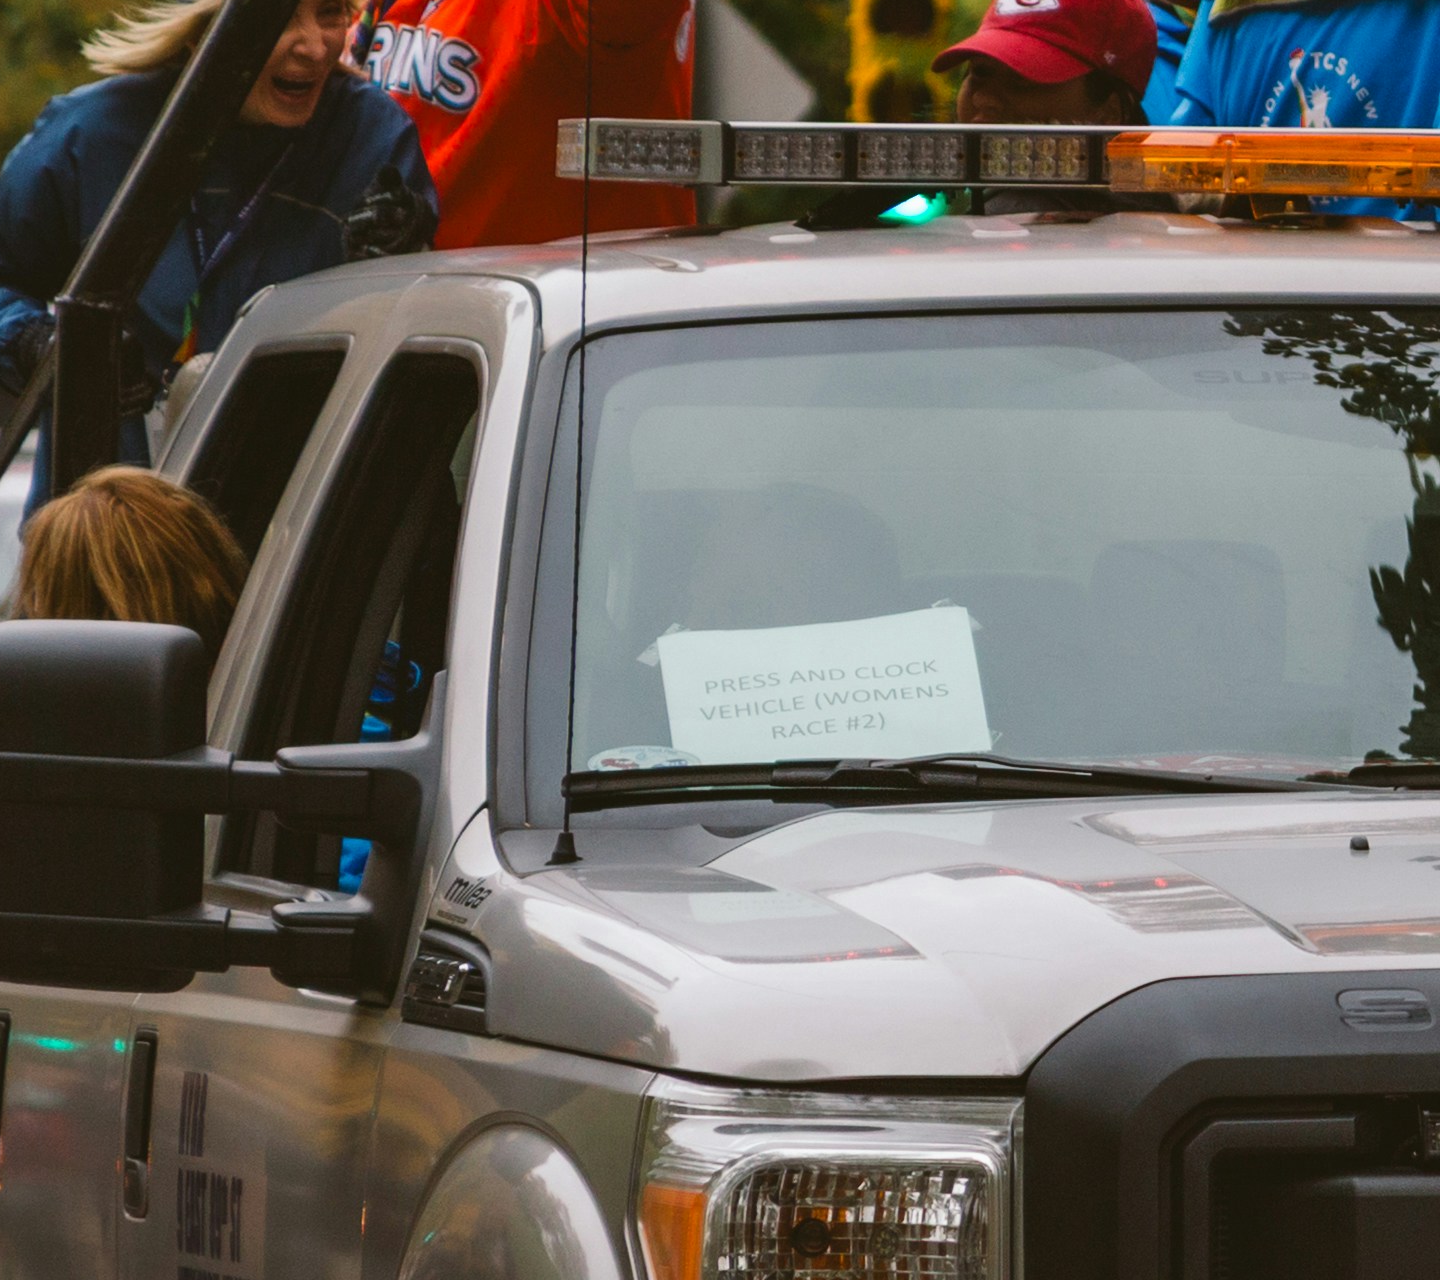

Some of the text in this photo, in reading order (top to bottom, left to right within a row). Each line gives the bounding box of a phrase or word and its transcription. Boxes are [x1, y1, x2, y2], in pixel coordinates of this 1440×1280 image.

[1310, 51, 1378, 119] TCS NEW
[704, 660, 938, 695] PRESS AND CLOCK
[699, 683, 950, 721] VEHICLE (WOMENS
[771, 718, 838, 740] RACE
